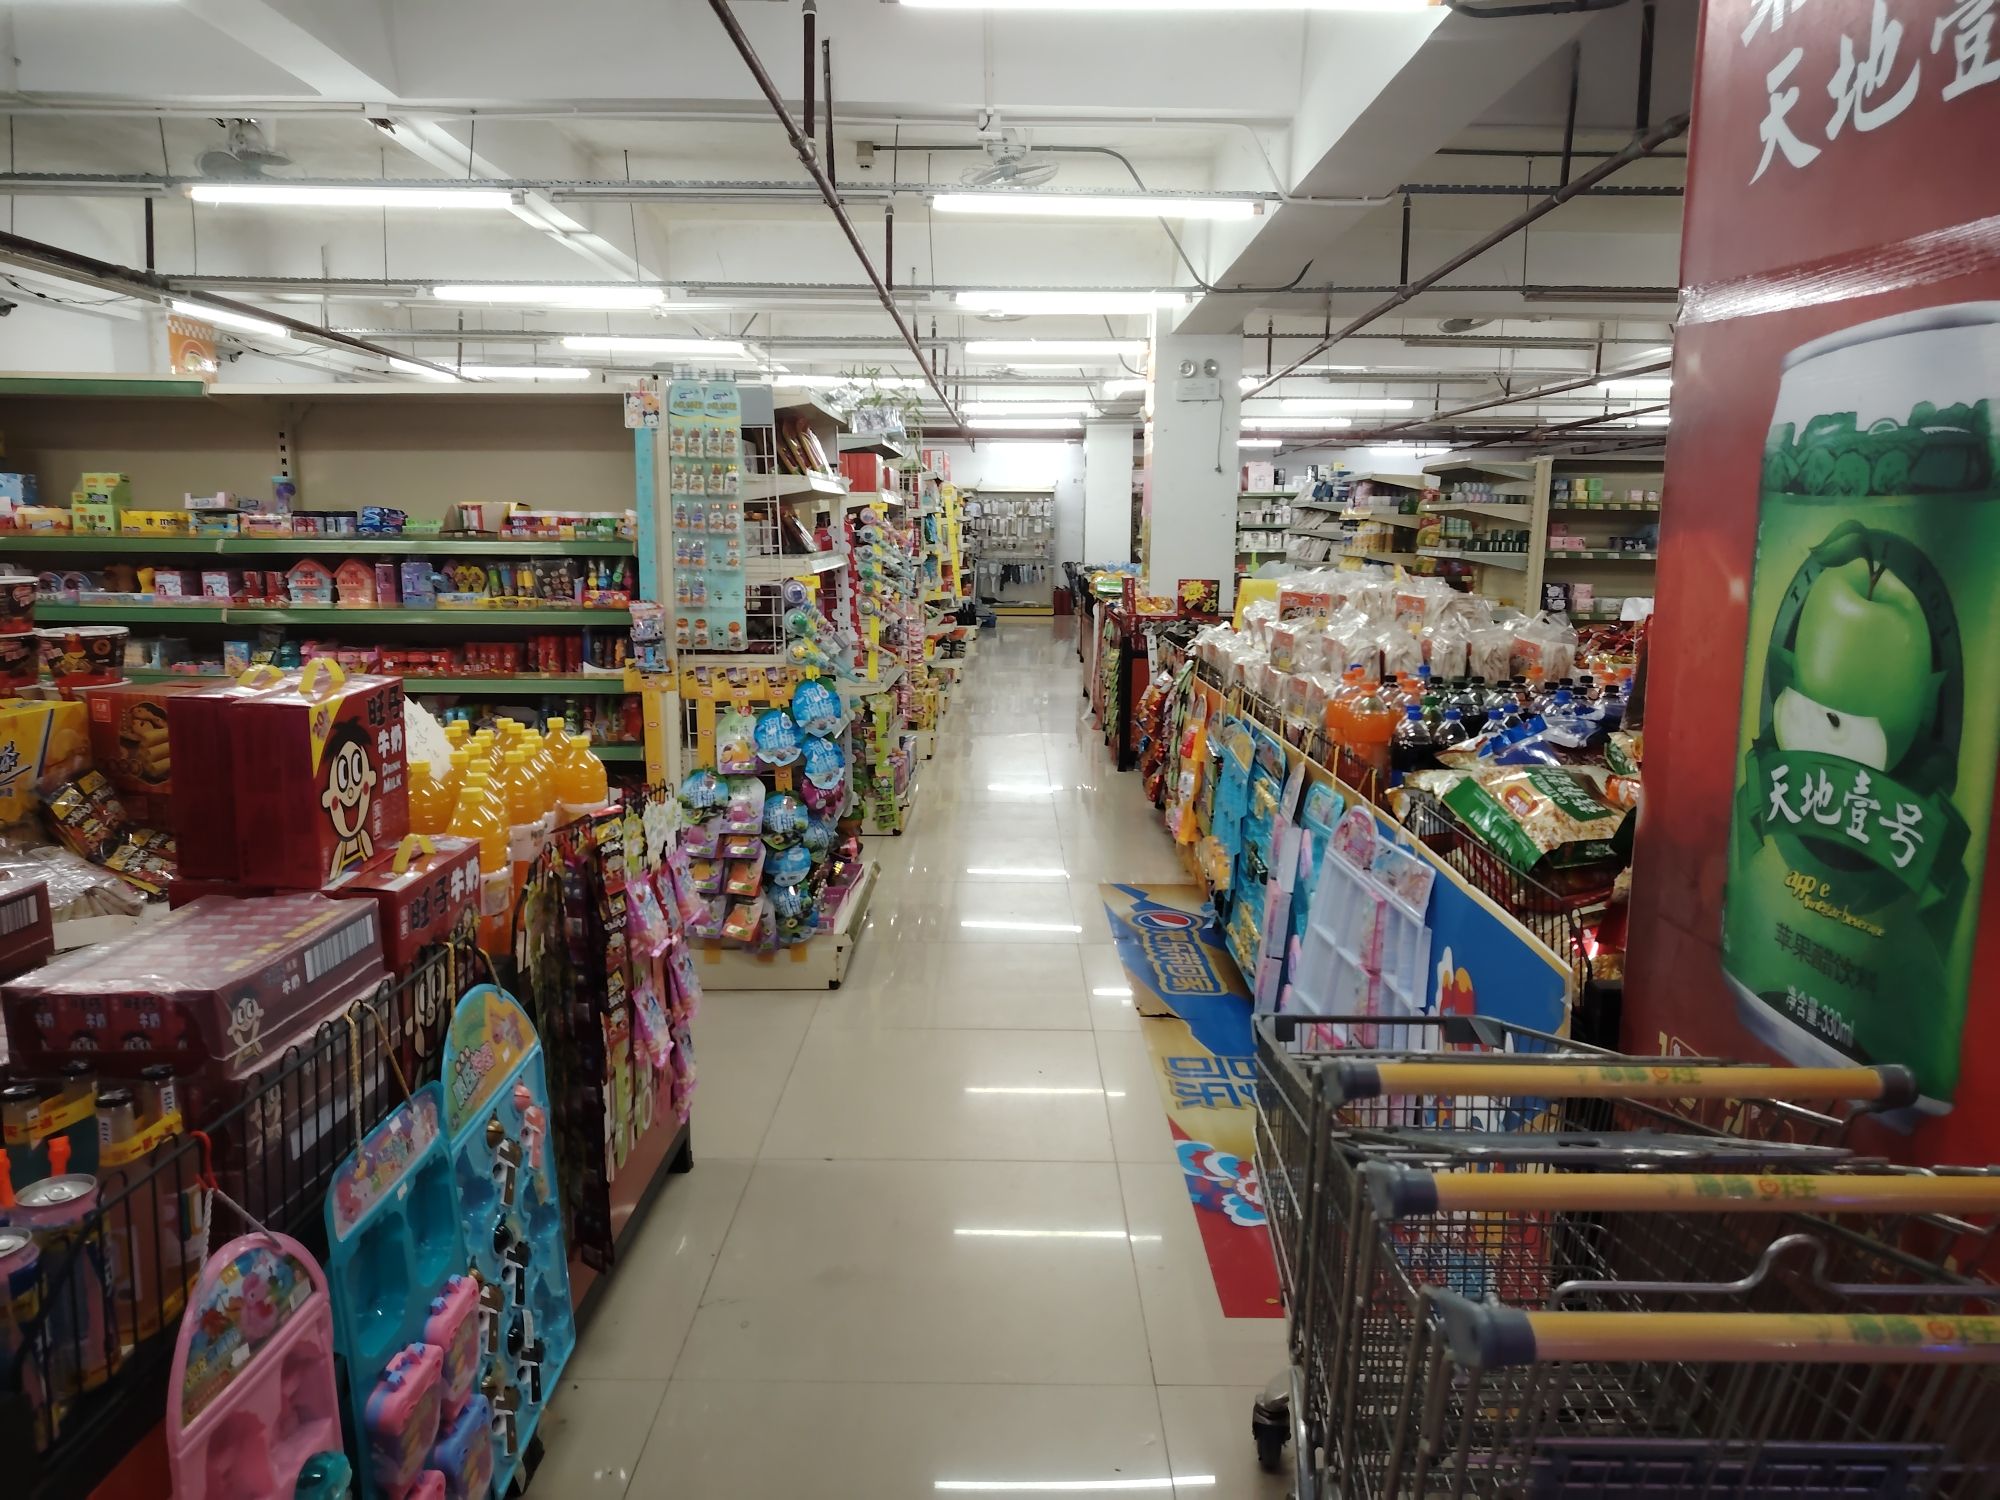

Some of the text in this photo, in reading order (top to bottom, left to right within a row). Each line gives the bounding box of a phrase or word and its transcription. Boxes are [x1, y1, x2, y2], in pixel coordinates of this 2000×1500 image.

[377, 723, 403, 759] 牛奶
[1766, 763, 1924, 868] 天地壹号
[1785, 870, 1831, 900] appe
